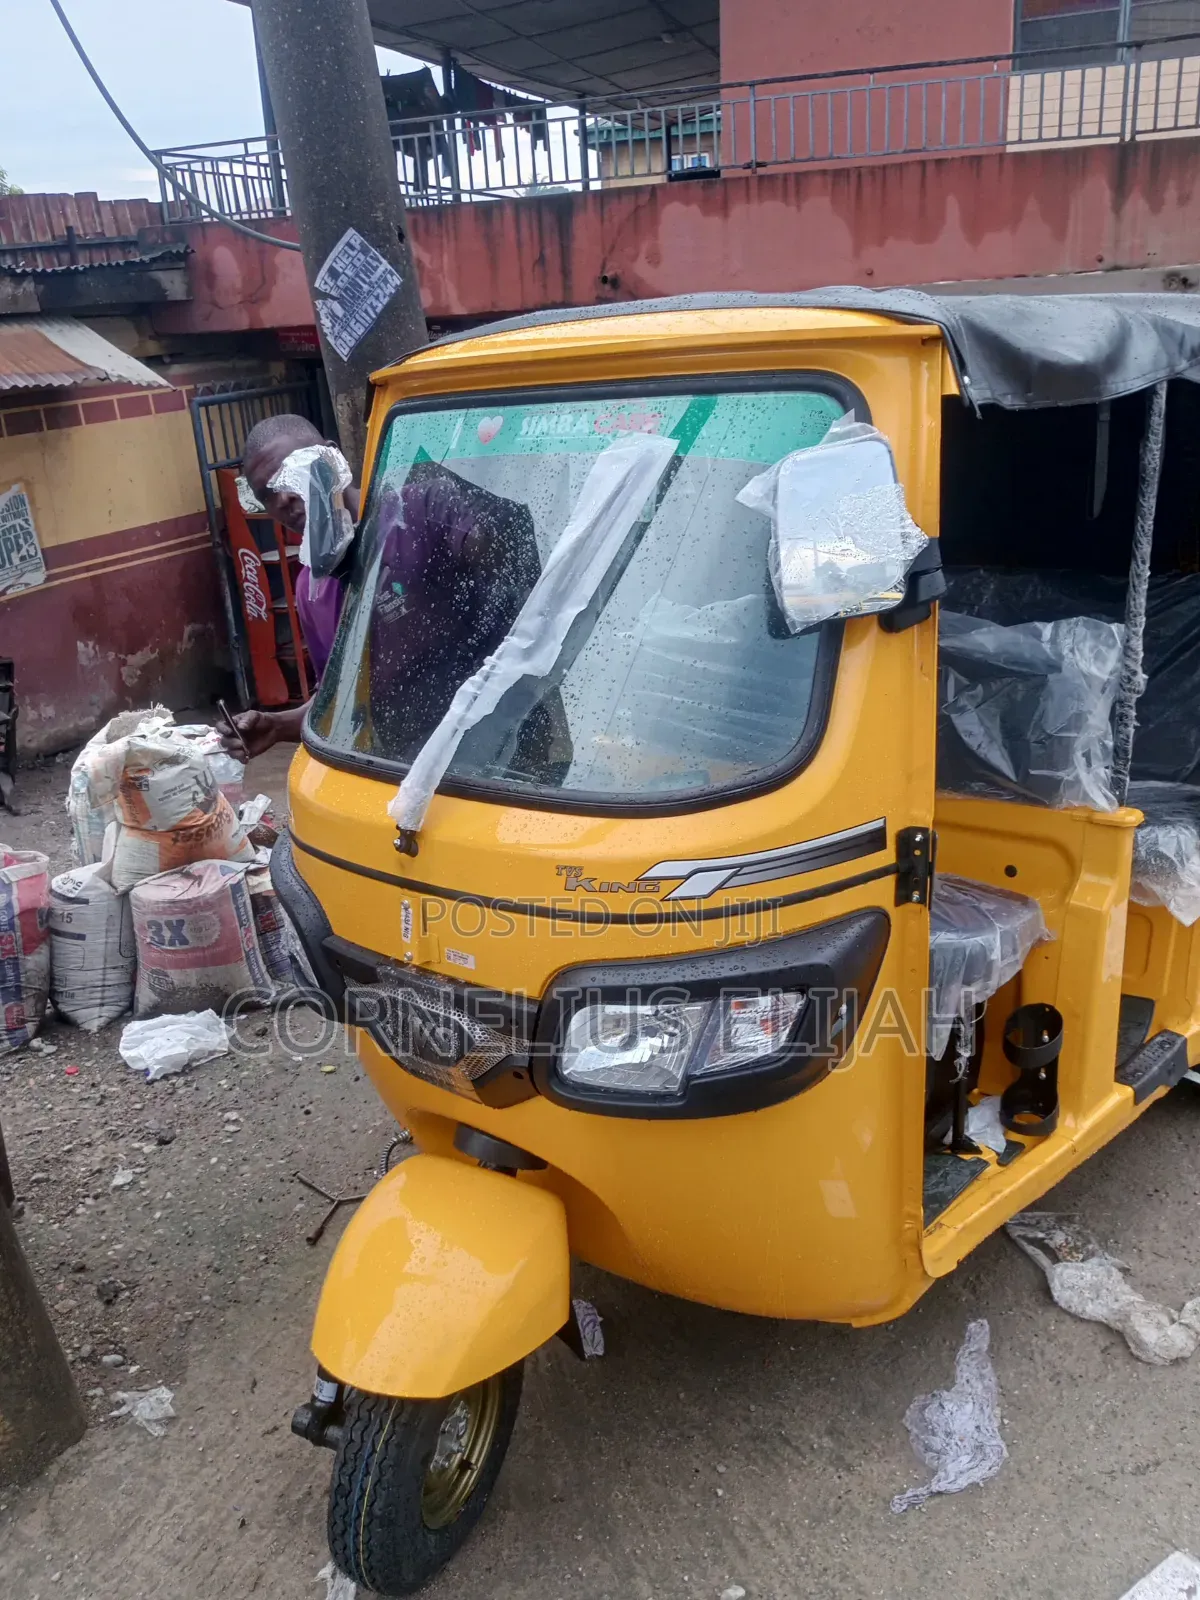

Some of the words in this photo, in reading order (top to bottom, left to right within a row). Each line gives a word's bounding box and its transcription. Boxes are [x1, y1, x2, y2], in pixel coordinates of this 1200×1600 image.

[331, 234, 363, 273] HELP
[519, 412, 590, 436] SIMBA
[0, 493, 27, 515] SION
[555, 864, 585, 878] TVS
[564, 876, 662, 894] KING
[60, 911, 73, 924] 15
[146, 918, 190, 947] 3X
